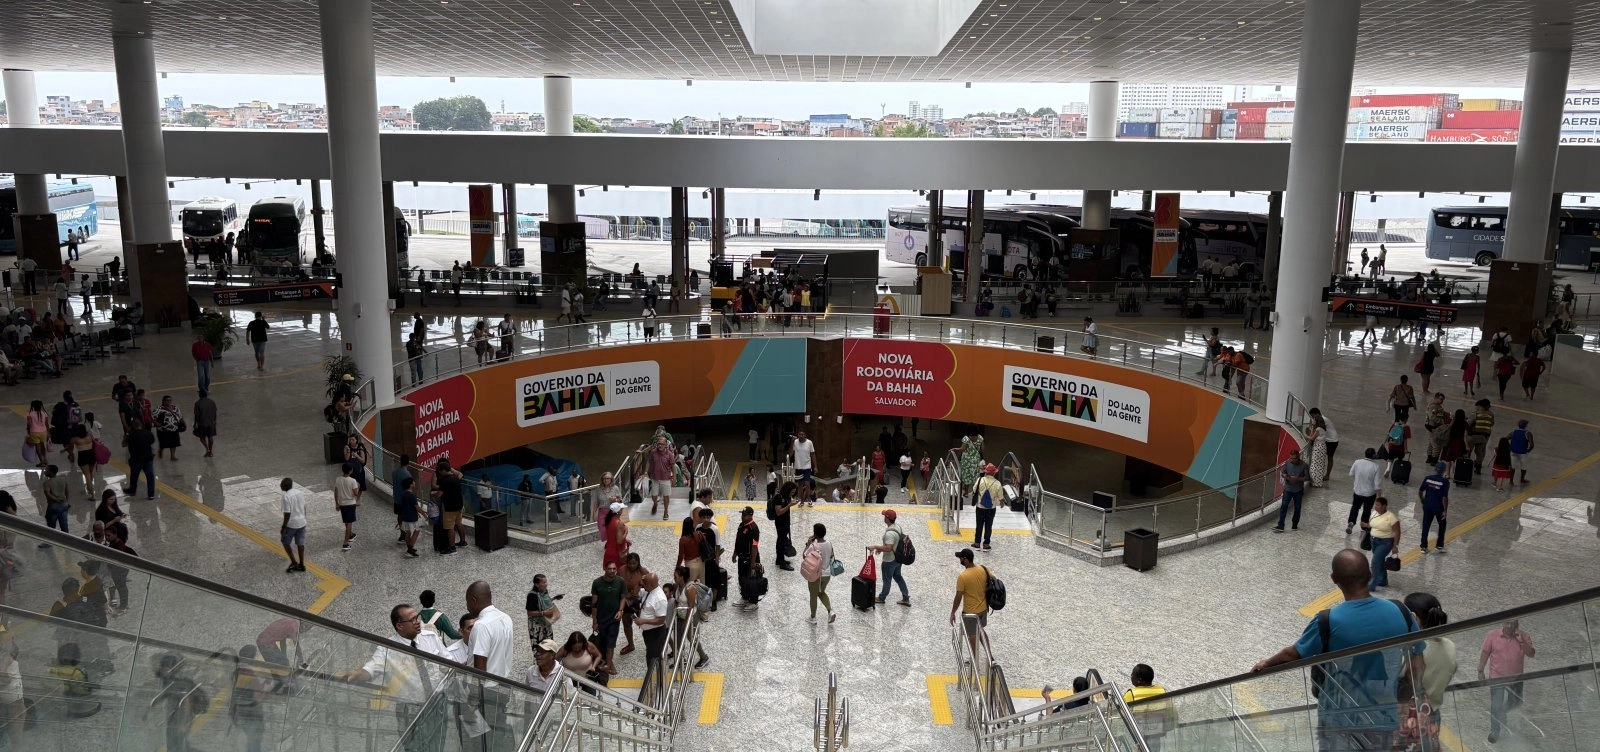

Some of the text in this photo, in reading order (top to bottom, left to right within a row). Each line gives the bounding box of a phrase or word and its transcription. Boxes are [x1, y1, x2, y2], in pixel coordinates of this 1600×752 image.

[878, 353, 913, 365] NOVA
[615, 376, 650, 387] DO LADO
[856, 366, 934, 382] RODOVIÁRIA
[523, 372, 605, 395] GOVERNO DA
[615, 384, 651, 395] DA GENTE
[866, 381, 923, 395] DA BAHIA
[1012, 372, 1098, 398] GOVERNO DA
[419, 397, 444, 419] NOVA
[524, 385, 605, 420] BAHIA
[874, 396, 917, 407] SALVADOR
[1011, 385, 1097, 423] BAHIA
[1108, 399, 1141, 414] DO LADO
[1107, 408, 1142, 424] DA GENTE
[427, 430, 454, 452] BAHIA
